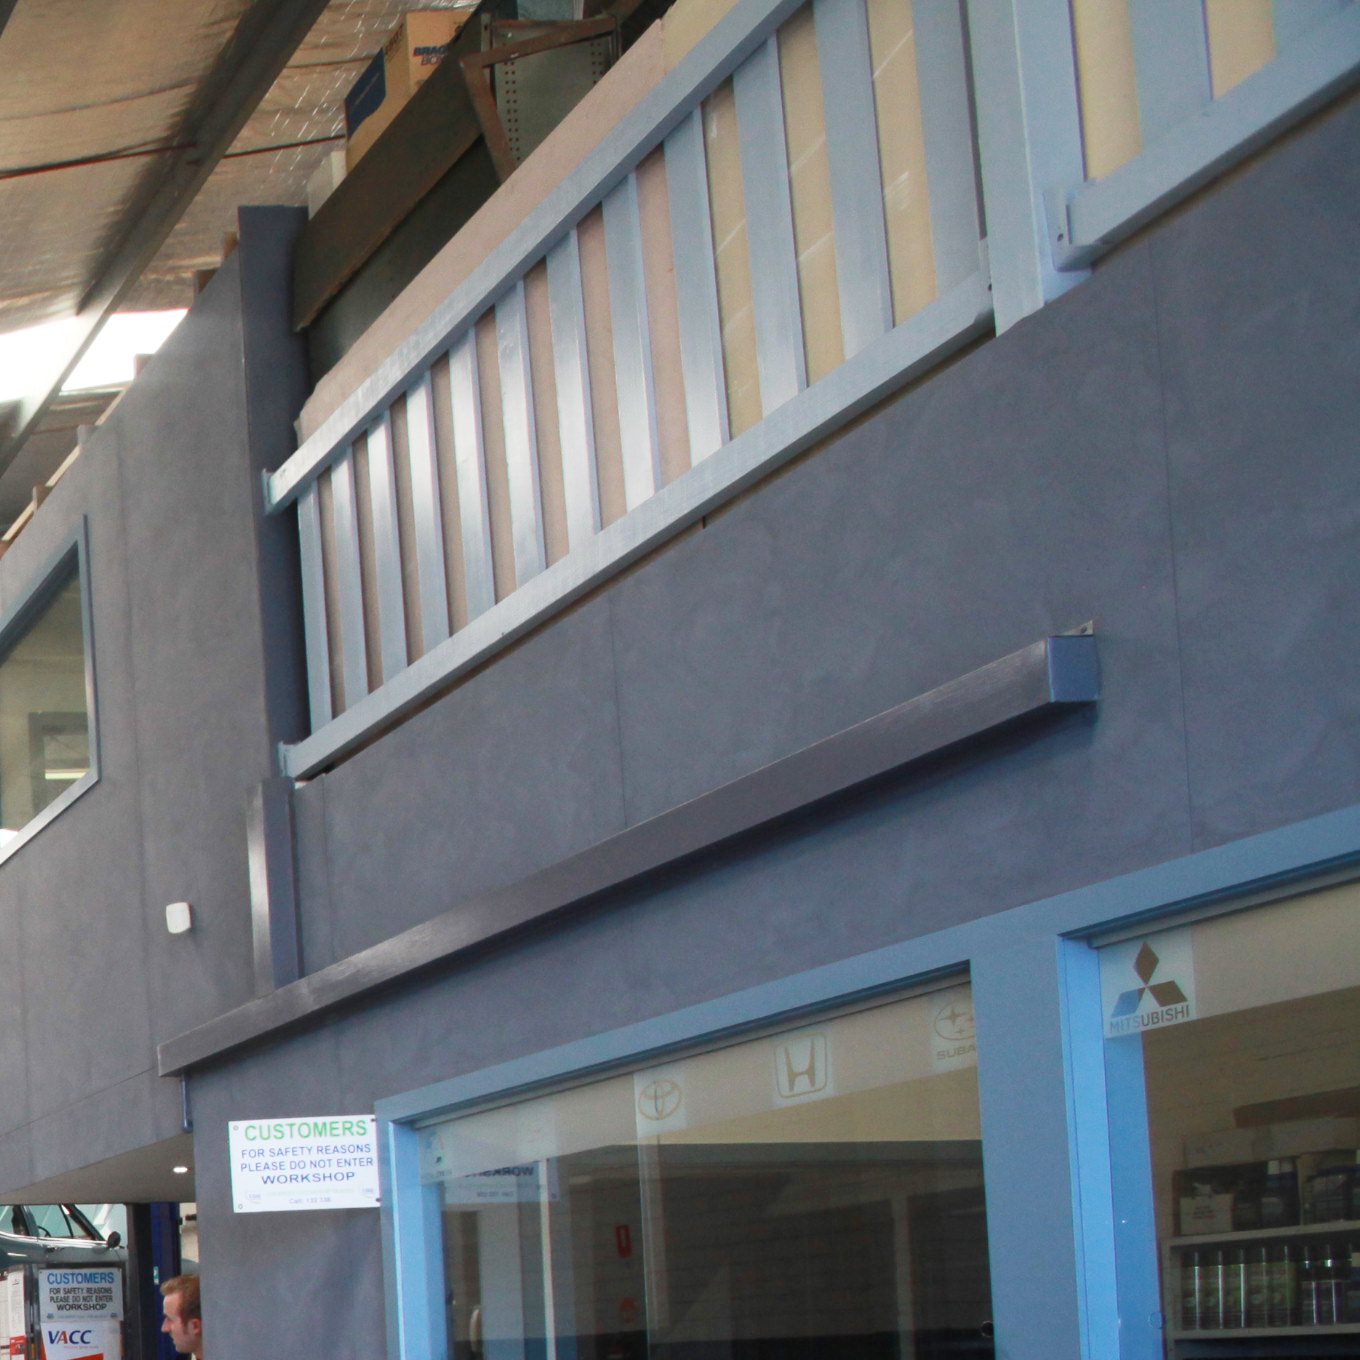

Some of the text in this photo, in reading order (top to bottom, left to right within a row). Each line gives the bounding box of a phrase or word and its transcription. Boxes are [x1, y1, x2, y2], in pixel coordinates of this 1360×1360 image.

[1109, 1004, 1190, 1034] MITSUBISHI
[936, 1044, 977, 1060] SUBA
[244, 1119, 368, 1141] CUSTOMERS
[241, 1143, 372, 1159] FOR SAFETY REASONS
[240, 1157, 374, 1172] PLEASE DO NOT ENTER
[261, 1171, 356, 1185] WORKSHOP
[47, 1272, 115, 1285] CUSTOMERS
[49, 1286, 113, 1295] FOR SAFETY REASONS
[49, 1295, 114, 1303] PLEASE DO NOT ENTER
[56, 1303, 107, 1312] WORKSHOP
[47, 1329, 93, 1345] VACC
